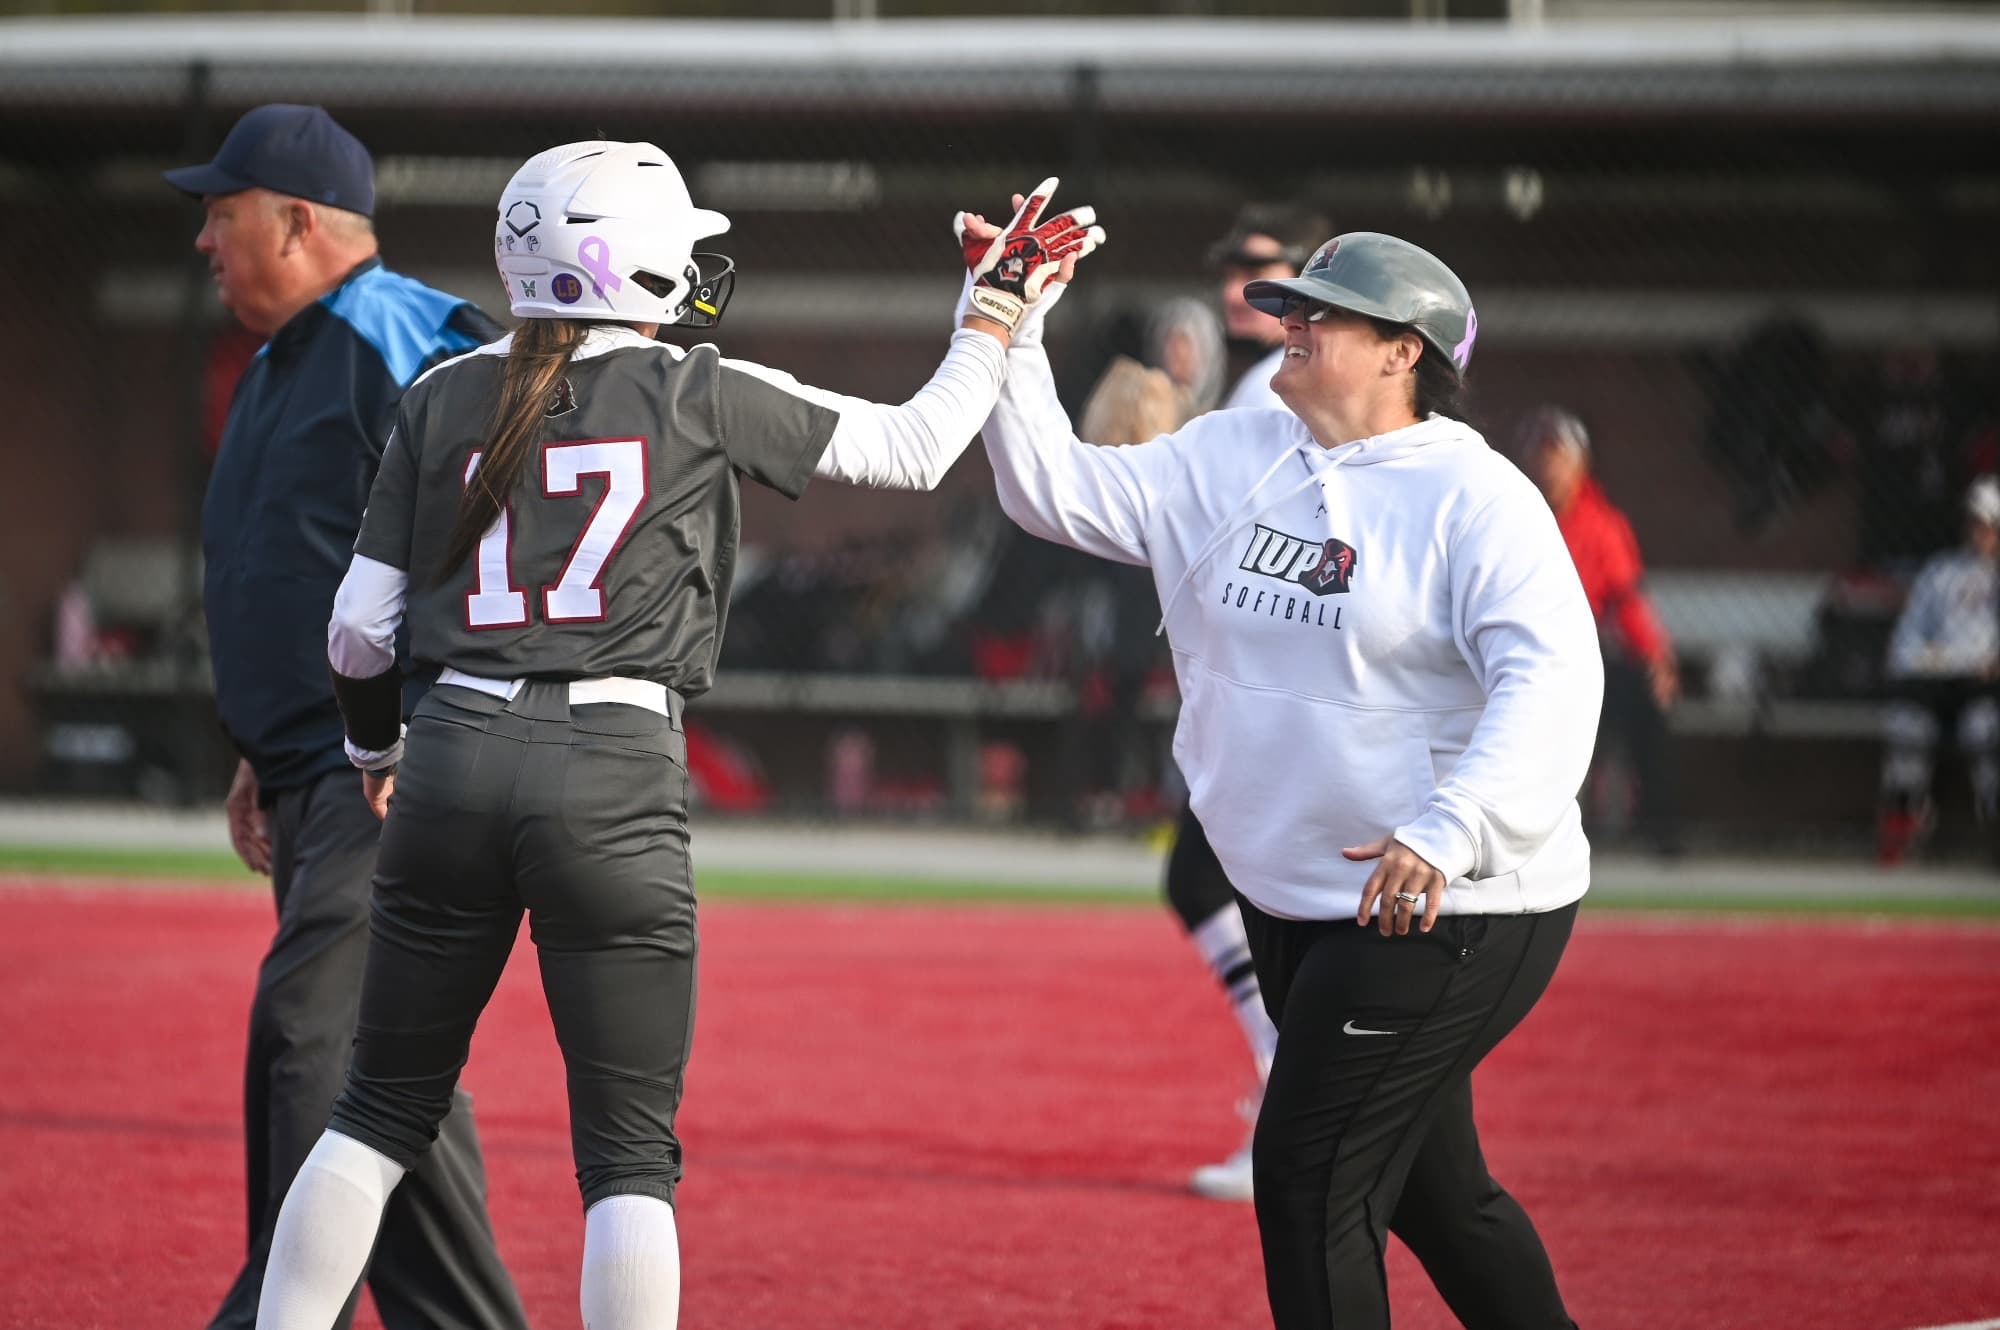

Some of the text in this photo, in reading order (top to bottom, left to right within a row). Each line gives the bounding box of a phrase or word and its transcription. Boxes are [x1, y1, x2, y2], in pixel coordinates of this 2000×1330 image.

[978, 295, 1017, 318] marucci
[464, 436, 650, 631] 17
[1239, 523, 1325, 583] IUP
[1222, 582, 1341, 630] SOFTBALL
